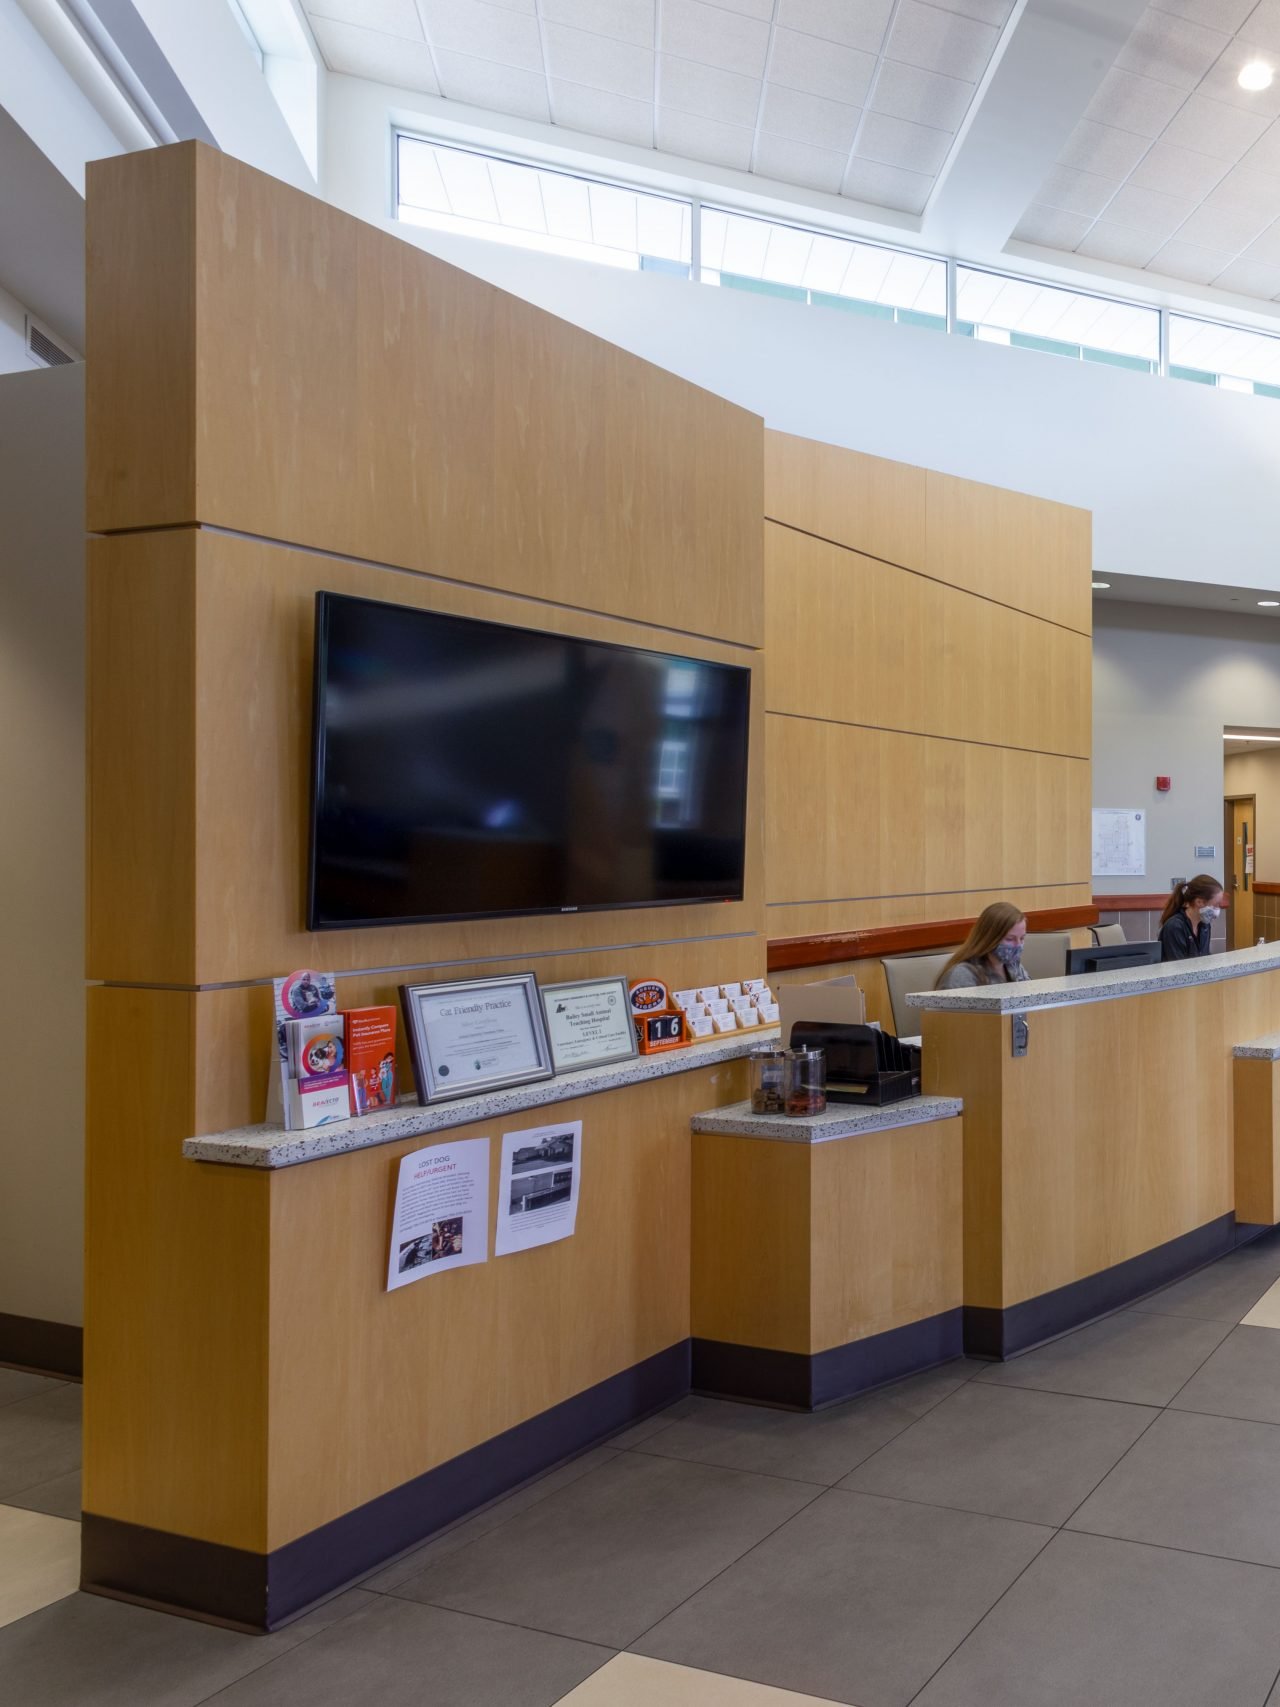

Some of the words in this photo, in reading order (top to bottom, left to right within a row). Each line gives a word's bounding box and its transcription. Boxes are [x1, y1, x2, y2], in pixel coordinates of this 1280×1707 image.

[635, 986, 660, 995] AUBURN
[440, 1008, 453, 1017] Cat
[454, 1003, 483, 1014] Friendly
[484, 1000, 512, 1011] Practice
[635, 999, 662, 1009] TIGERS
[581, 1010, 594, 1018] Small
[595, 1007, 612, 1015] Animal
[569, 1018, 590, 1027] Teaching
[591, 1014, 610, 1023] Hospital
[371, 1023, 389, 1031] Compare
[650, 1037, 679, 1047] SEPTEMBER
[418, 1159, 433, 1169] LOST
[434, 1155, 450, 1165] DOG
[413, 1163, 457, 1179] HELP/URGENT
